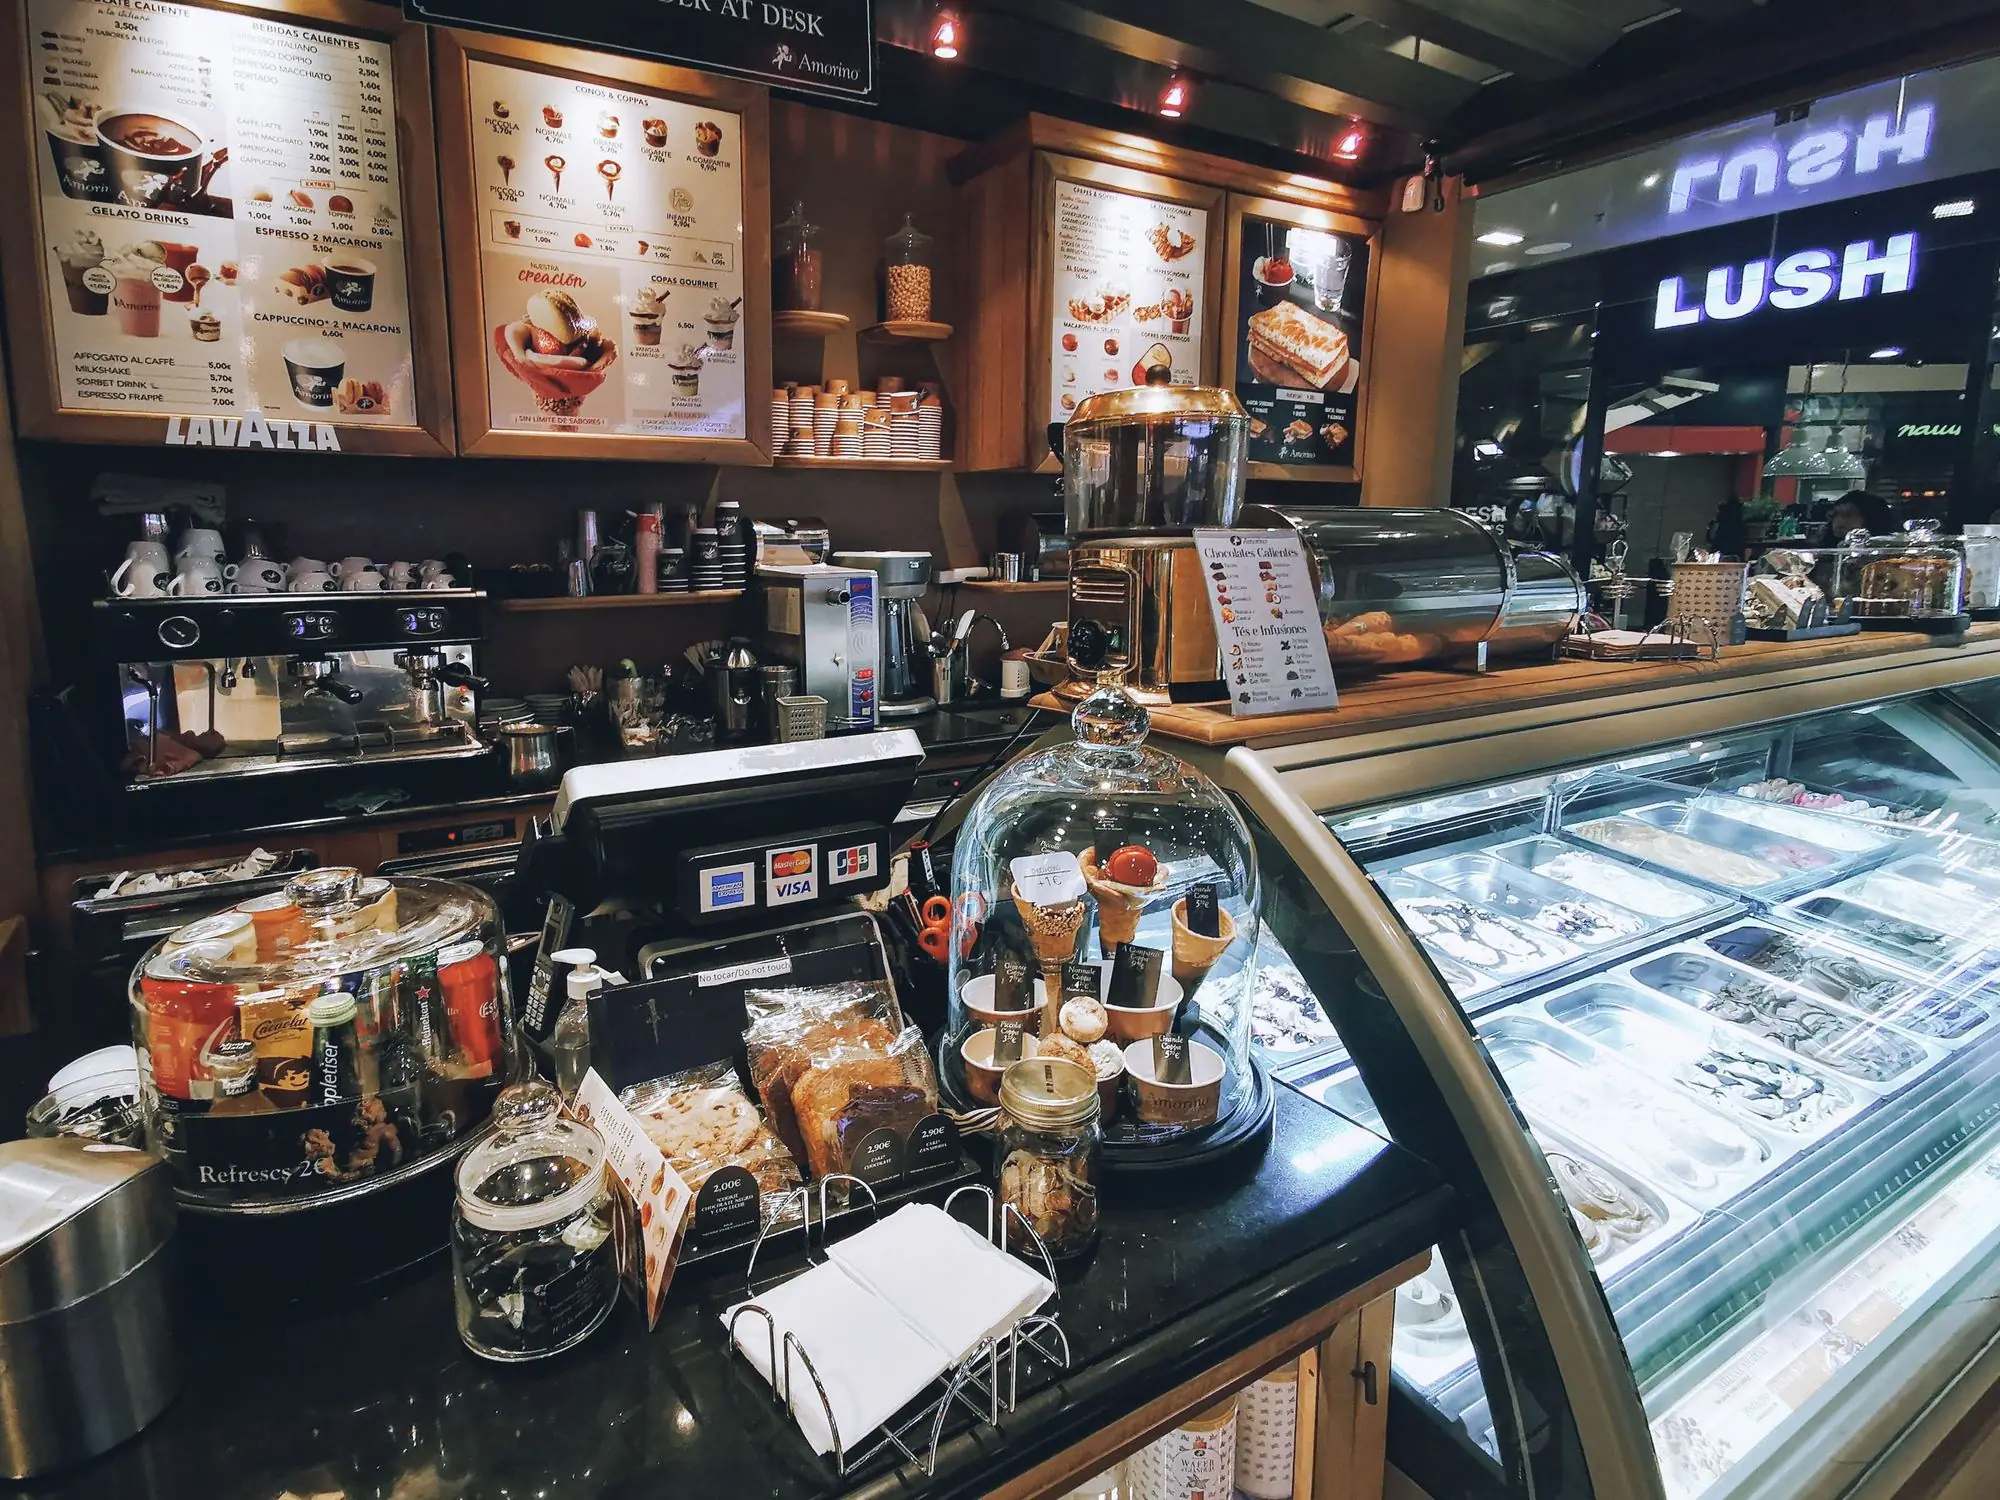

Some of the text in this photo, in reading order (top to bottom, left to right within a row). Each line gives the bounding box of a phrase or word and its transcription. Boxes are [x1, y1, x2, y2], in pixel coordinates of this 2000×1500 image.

[135, 1, 191, 18] CALIENTE
[720, 0, 754, 21] AT
[762, 3, 825, 38] DESK
[252, 22, 361, 51] BEBIDAS CALIENTES
[277, 39, 318, 55] ITALIANO
[278, 52, 313, 66] DOPPIO
[279, 65, 332, 82] MACCHIATO
[798, 54, 860, 82] Amorino
[574, 84, 606, 97] CONOS
[616, 93, 650, 107] COPPAS
[484, 118, 520, 132] PICCOLA
[308, 128, 387, 148] 1,90€ 3,00€ 4,00€
[535, 127, 573, 142] NORMALE
[309, 140, 387, 159] 1,90€ 3,00€ 4,00€
[640, 145, 673, 160] GIGANTE
[309, 153, 388, 172] 2,00€ 3,00€ 4,00€
[310, 165, 331, 176] 3,00€
[339, 170, 361, 180] 4,00€
[489, 185, 525, 199] PICCOLO
[539, 192, 577, 206] NORMALE
[91, 206, 190, 226] GELATO DRINKS
[247, 211, 273, 221] 1,00€
[289, 216, 313, 226] 1,80€
[331, 221, 354, 232] 1,00€
[255, 226, 384, 250] ESPRESSO 2 MACARONS
[312, 244, 333, 254] 5,10€
[518, 270, 588, 289] creación
[651, 274, 719, 290] COPAS GOURMET
[1654, 232, 1918, 330] LUSH
[333, 321, 402, 335] 2 MACARONS
[73, 352, 129, 364] AFFOGATO
[130, 356, 144, 364] AL
[208, 361, 232, 371] 5,00€
[75, 364, 132, 376] MILKSHAKE
[76, 377, 148, 390] SORBET DRINK
[209, 374, 233, 383] 5,70€
[77, 390, 127, 401] ESPRESSO
[211, 386, 234, 395] 5,70€
[212, 398, 236, 407] 7,00€
[165, 410, 342, 452] LAVAZZA
[1204, 547, 1299, 560] Chocolates Calientes
[1232, 626, 1250, 638] Tés
[1259, 624, 1308, 637] Infusiones
[840, 853, 869, 869] JCB
[777, 880, 812, 898] VISA
[700, 961, 791, 983] No tocar/Do not touch
[253, 1014, 308, 1041] Cacaolat
[421, 1000, 434, 1049] Heineken
[922, 1125, 946, 1139] 2,90€
[866, 1140, 892, 1155] 2,90€
[199, 1165, 291, 1184] Refrescs
[713, 1178, 742, 1194] 2,00€
